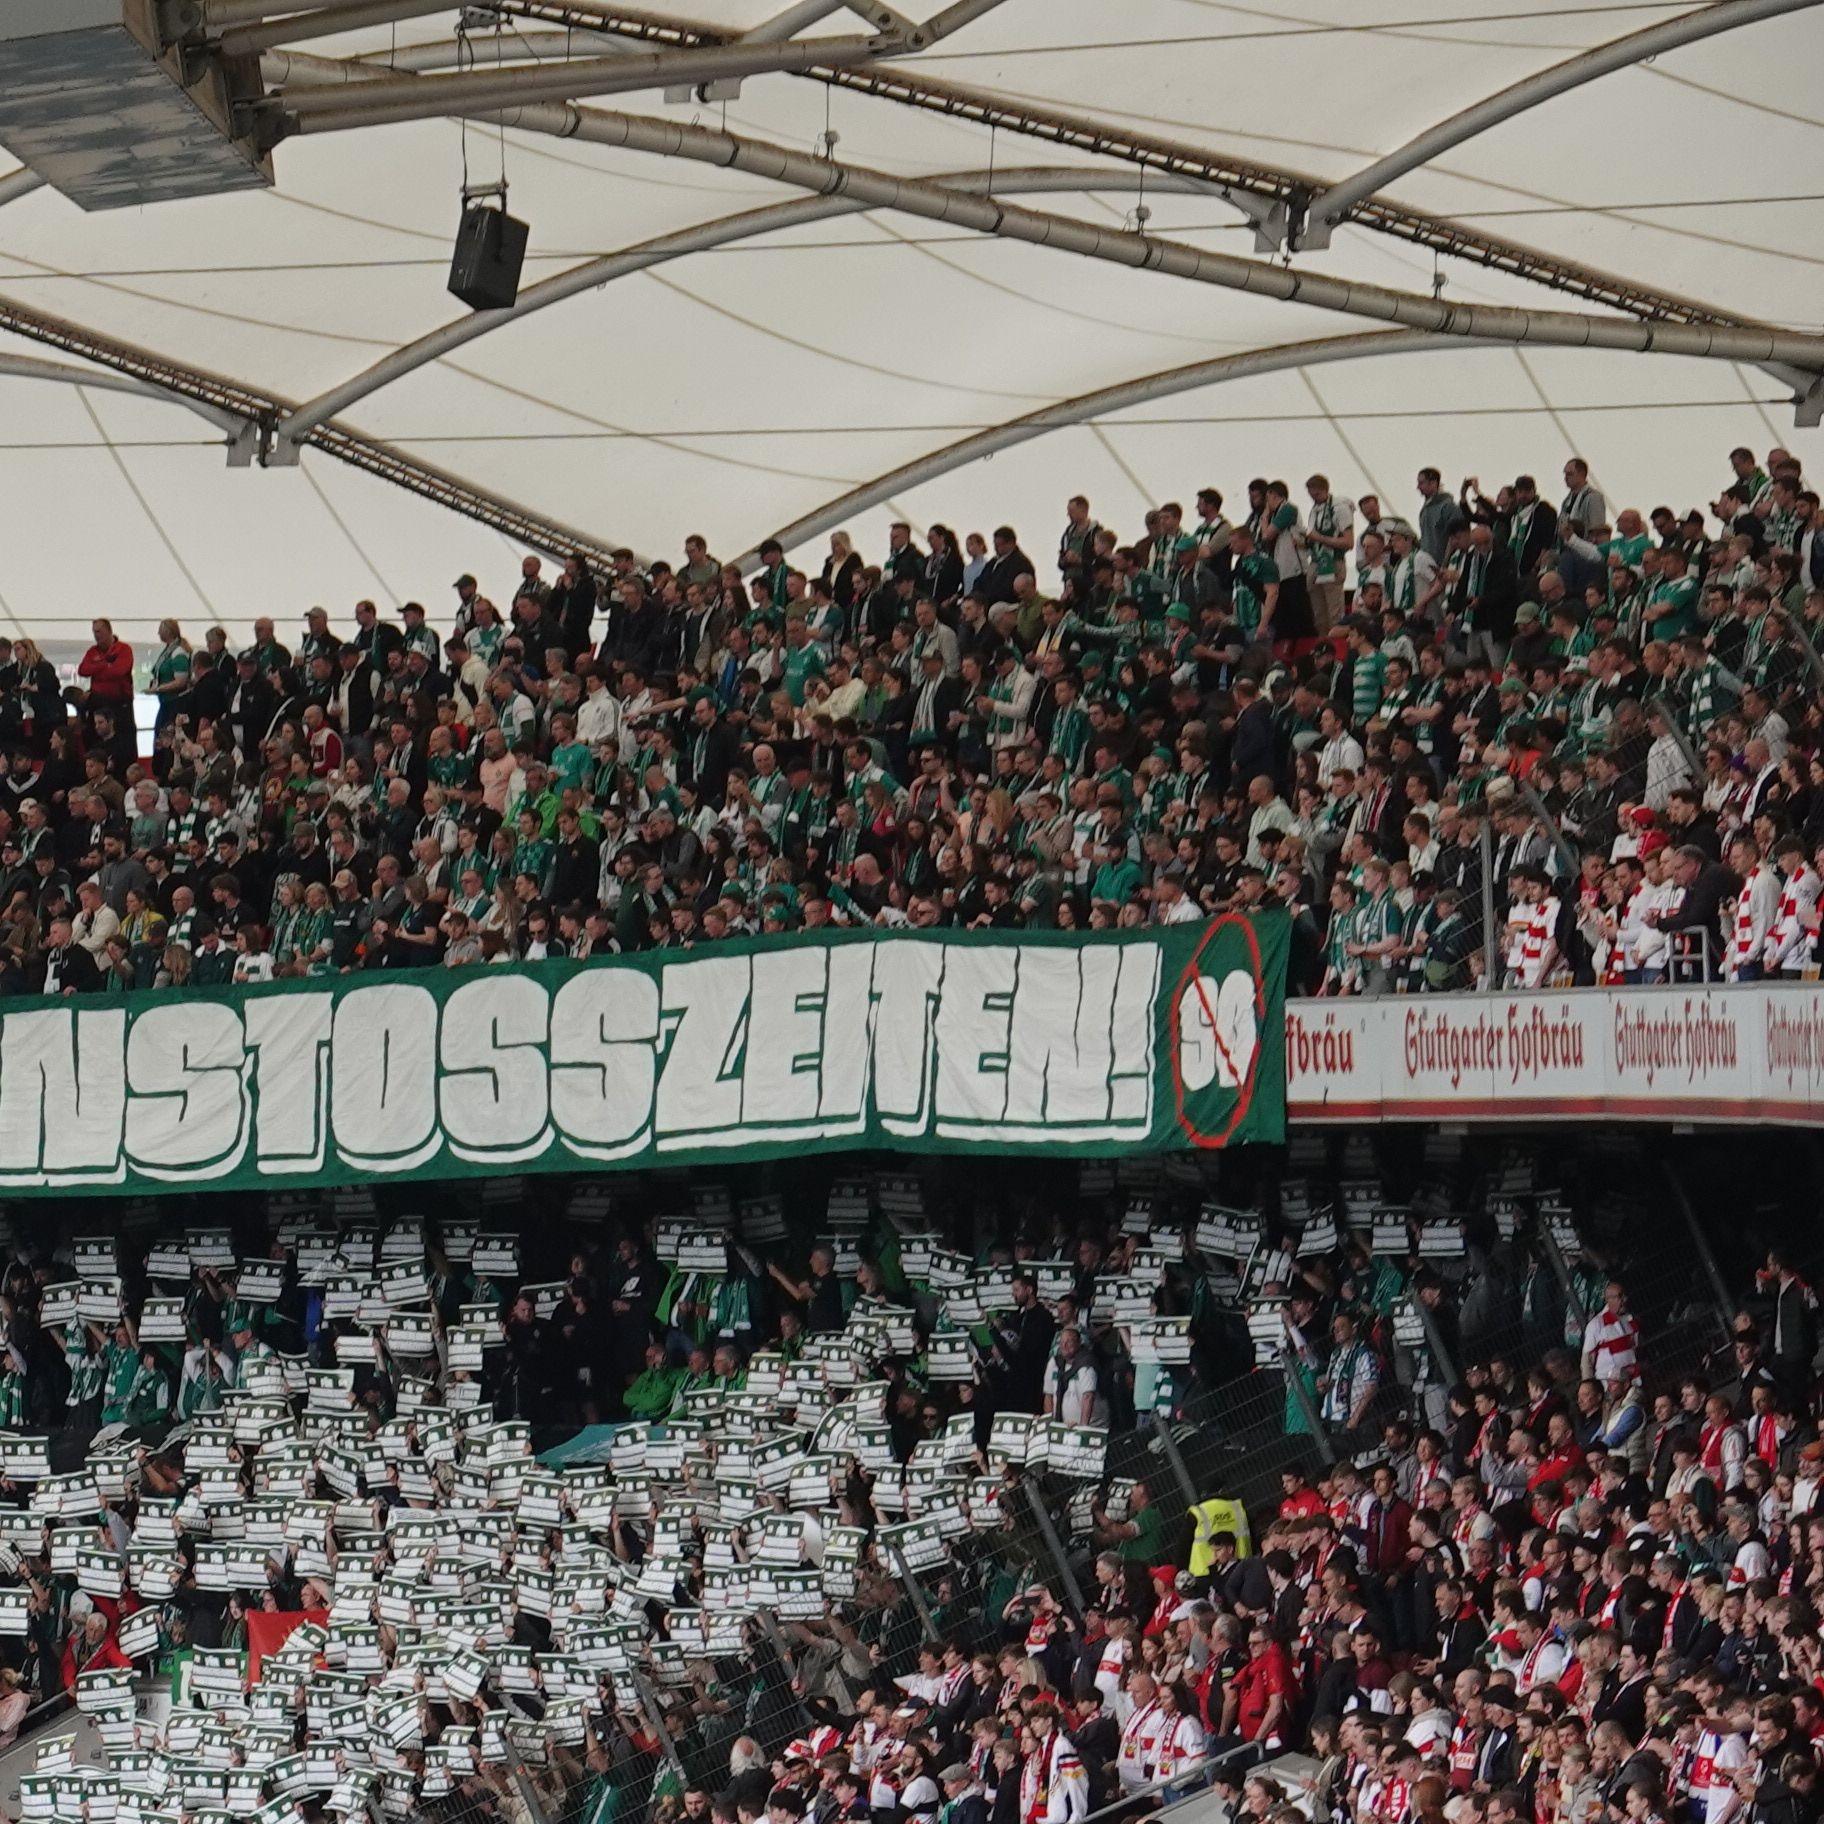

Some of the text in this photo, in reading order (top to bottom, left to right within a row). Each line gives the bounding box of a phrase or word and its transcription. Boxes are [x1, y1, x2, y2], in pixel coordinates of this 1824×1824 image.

[1404, 1002, 1584, 1089] Stuttgarter Hofbräu
[1614, 1000, 1683, 1086] Stuttgarter
[1685, 996, 1738, 1084] Hofbräu
